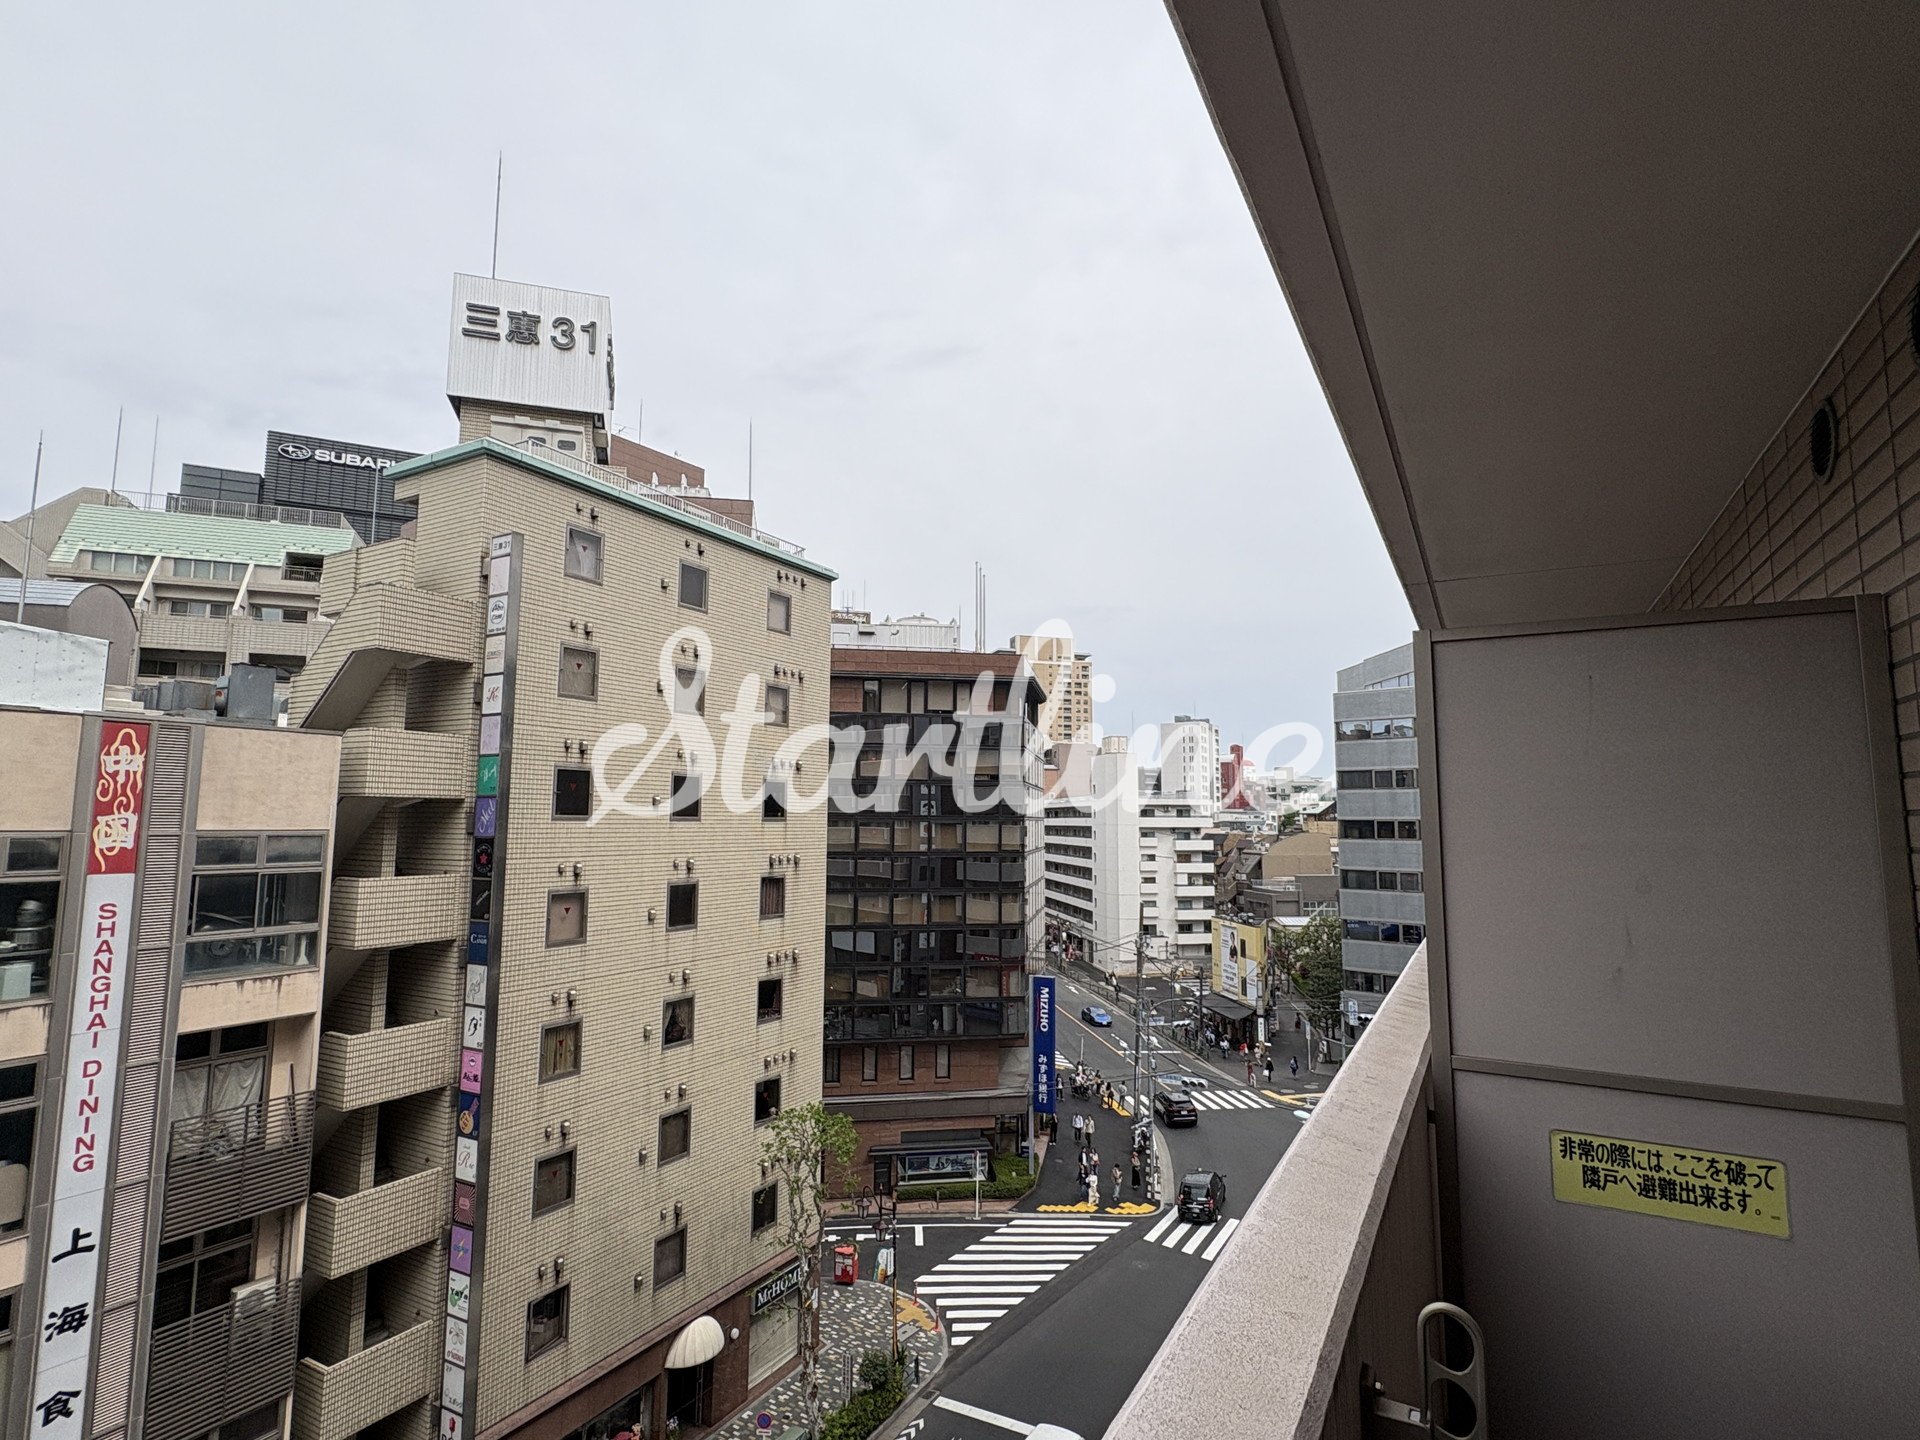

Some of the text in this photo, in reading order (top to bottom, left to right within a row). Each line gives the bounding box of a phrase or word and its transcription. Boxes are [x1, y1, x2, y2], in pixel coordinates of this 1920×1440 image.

[1039, 986, 1050, 1033] MIZUHO
[72, 902, 118, 1173] SHANGHAI DINING
[1038, 1053, 1048, 1104] みずほ銀行
[1558, 1135, 1777, 1192] 非常の際には、ここを破って
[1581, 1163, 1762, 1216] 隣戸へ避難出来ます。
